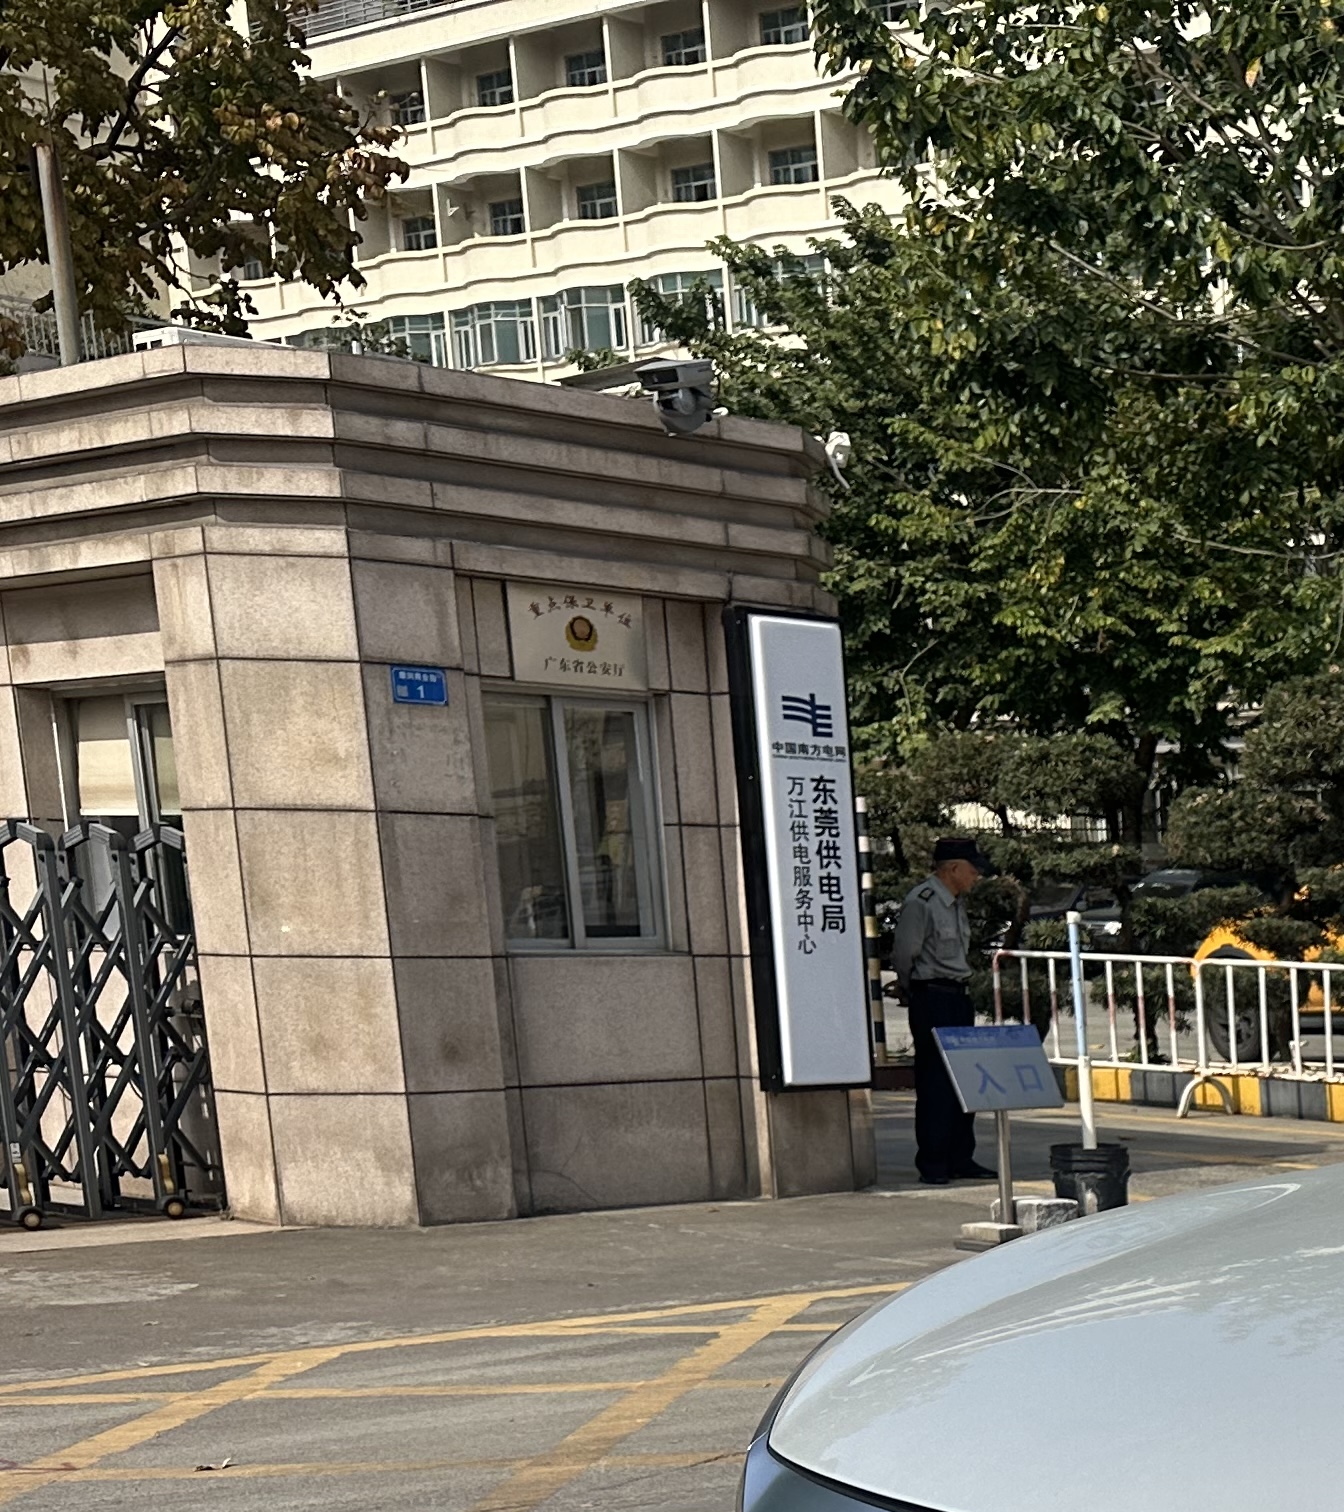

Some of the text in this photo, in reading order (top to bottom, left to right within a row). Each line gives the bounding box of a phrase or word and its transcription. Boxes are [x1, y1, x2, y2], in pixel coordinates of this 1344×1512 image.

[543, 656, 625, 677] 广东省公安厅
[771, 740, 847, 758] 中国南方电网
[786, 776, 817, 956] 万江供电服务中心
[810, 774, 847, 935] 东莞供电局
[975, 1062, 1045, 1096] 入口
